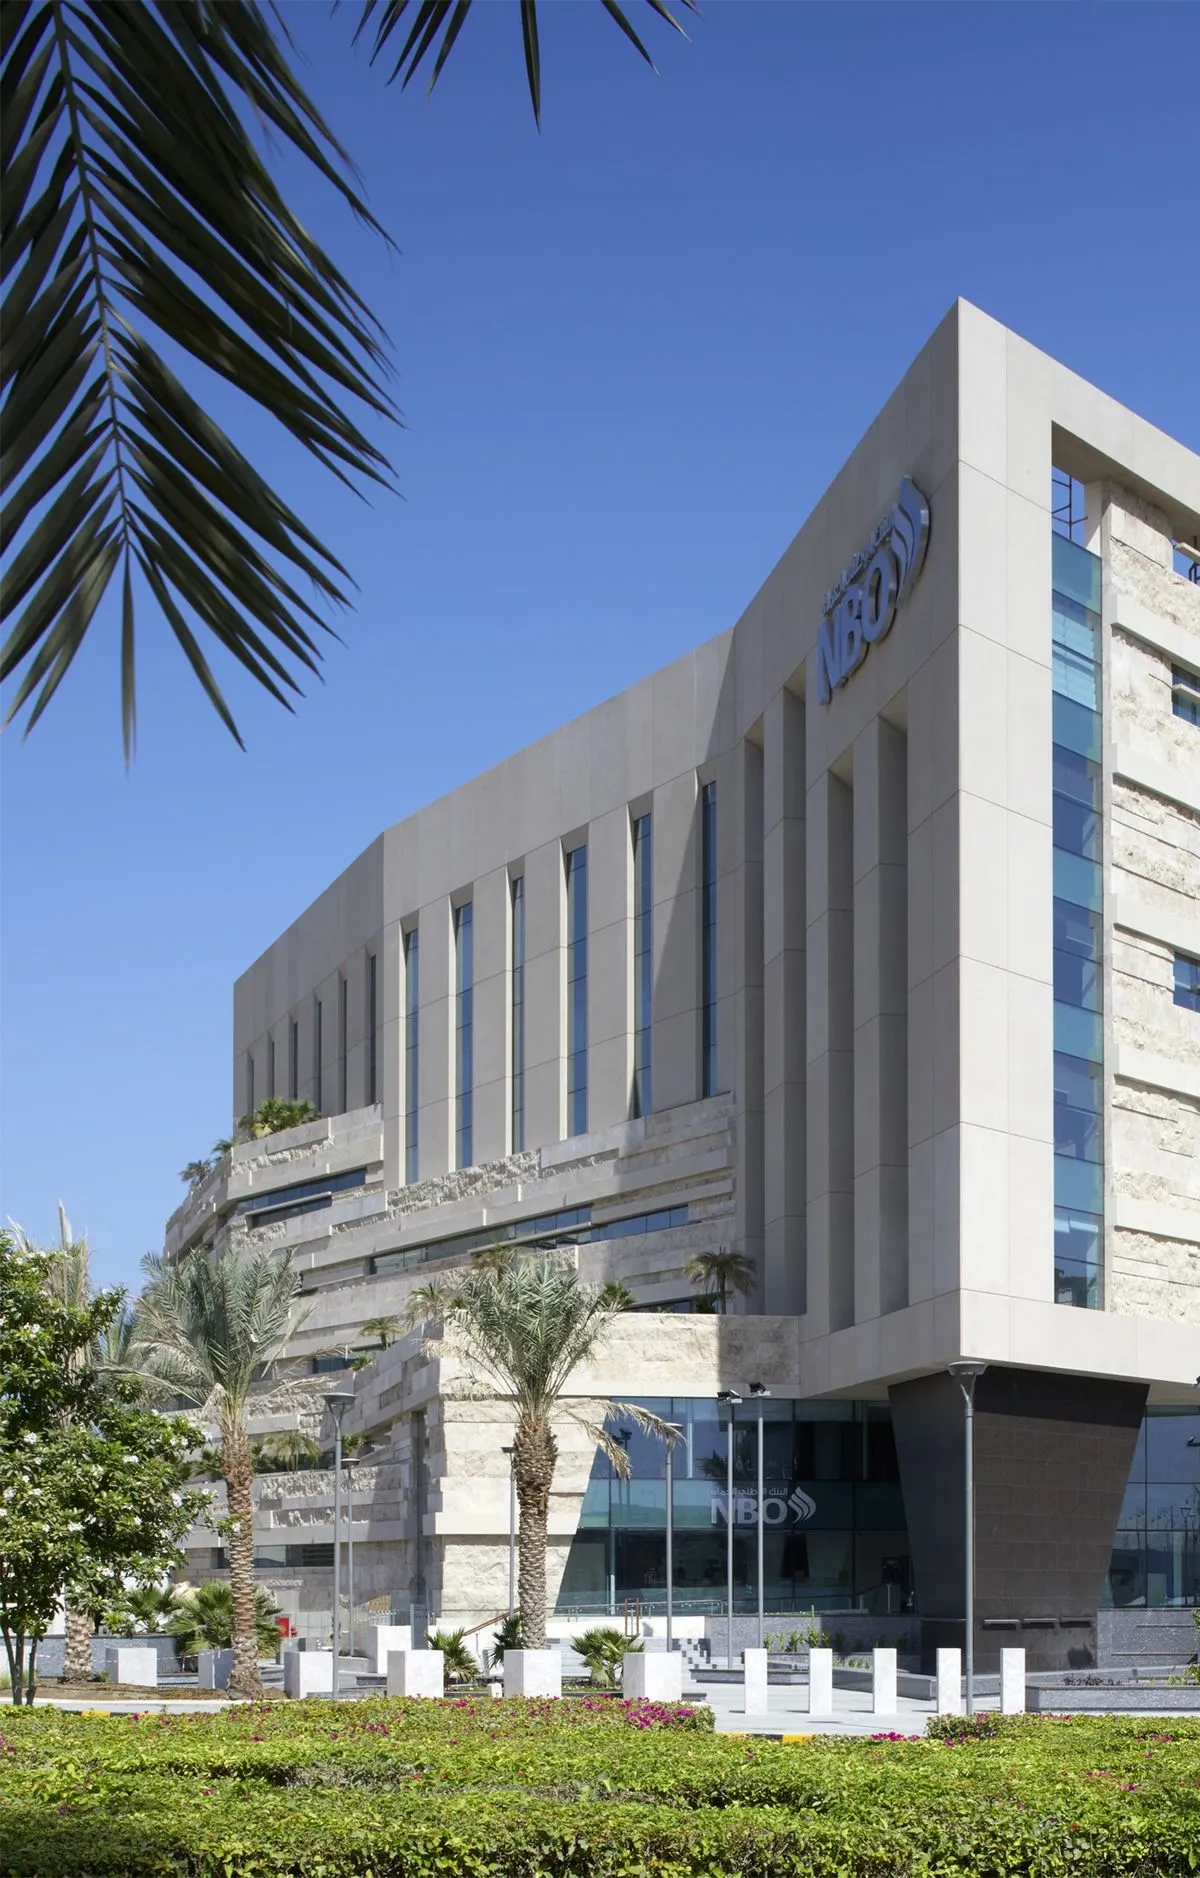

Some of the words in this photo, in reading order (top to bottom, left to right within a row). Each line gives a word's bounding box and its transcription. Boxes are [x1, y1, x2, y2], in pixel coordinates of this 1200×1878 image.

[817, 551, 897, 705] NBO
[768, 1487, 788, 1496] البنك
[711, 1498, 788, 1525] NBO
